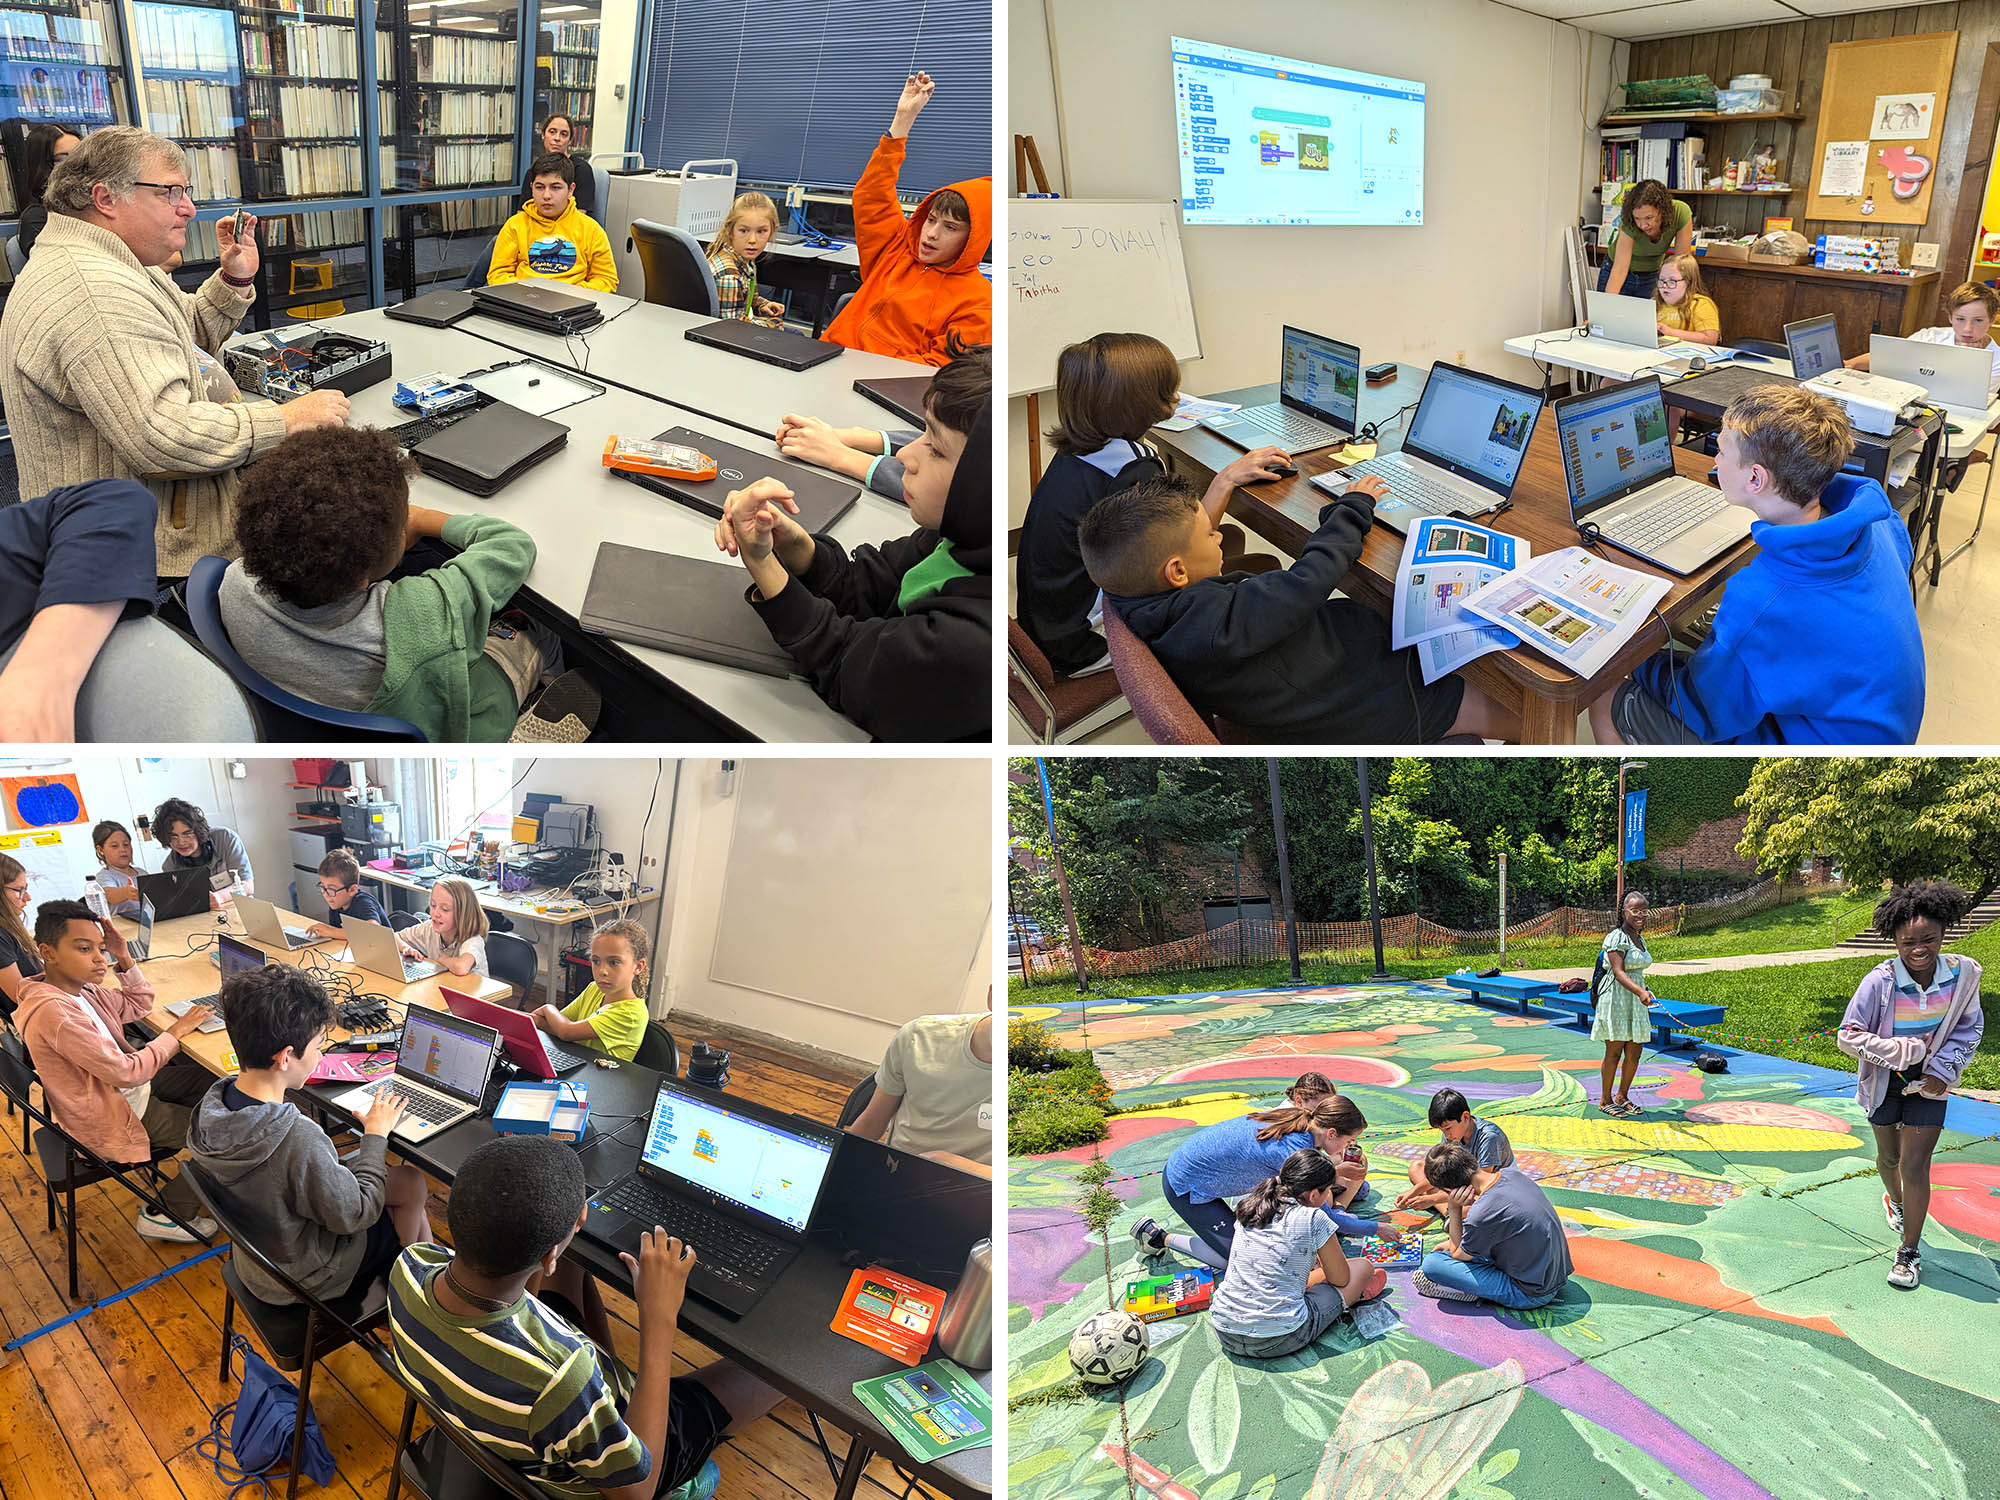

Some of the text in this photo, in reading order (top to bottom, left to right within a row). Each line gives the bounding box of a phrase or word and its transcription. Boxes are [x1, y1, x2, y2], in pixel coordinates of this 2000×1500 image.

[1061, 226, 1161, 259] JONAH
[1016, 284, 1060, 303] Tabitha
[1167, 1279, 1185, 1304] Blokus
